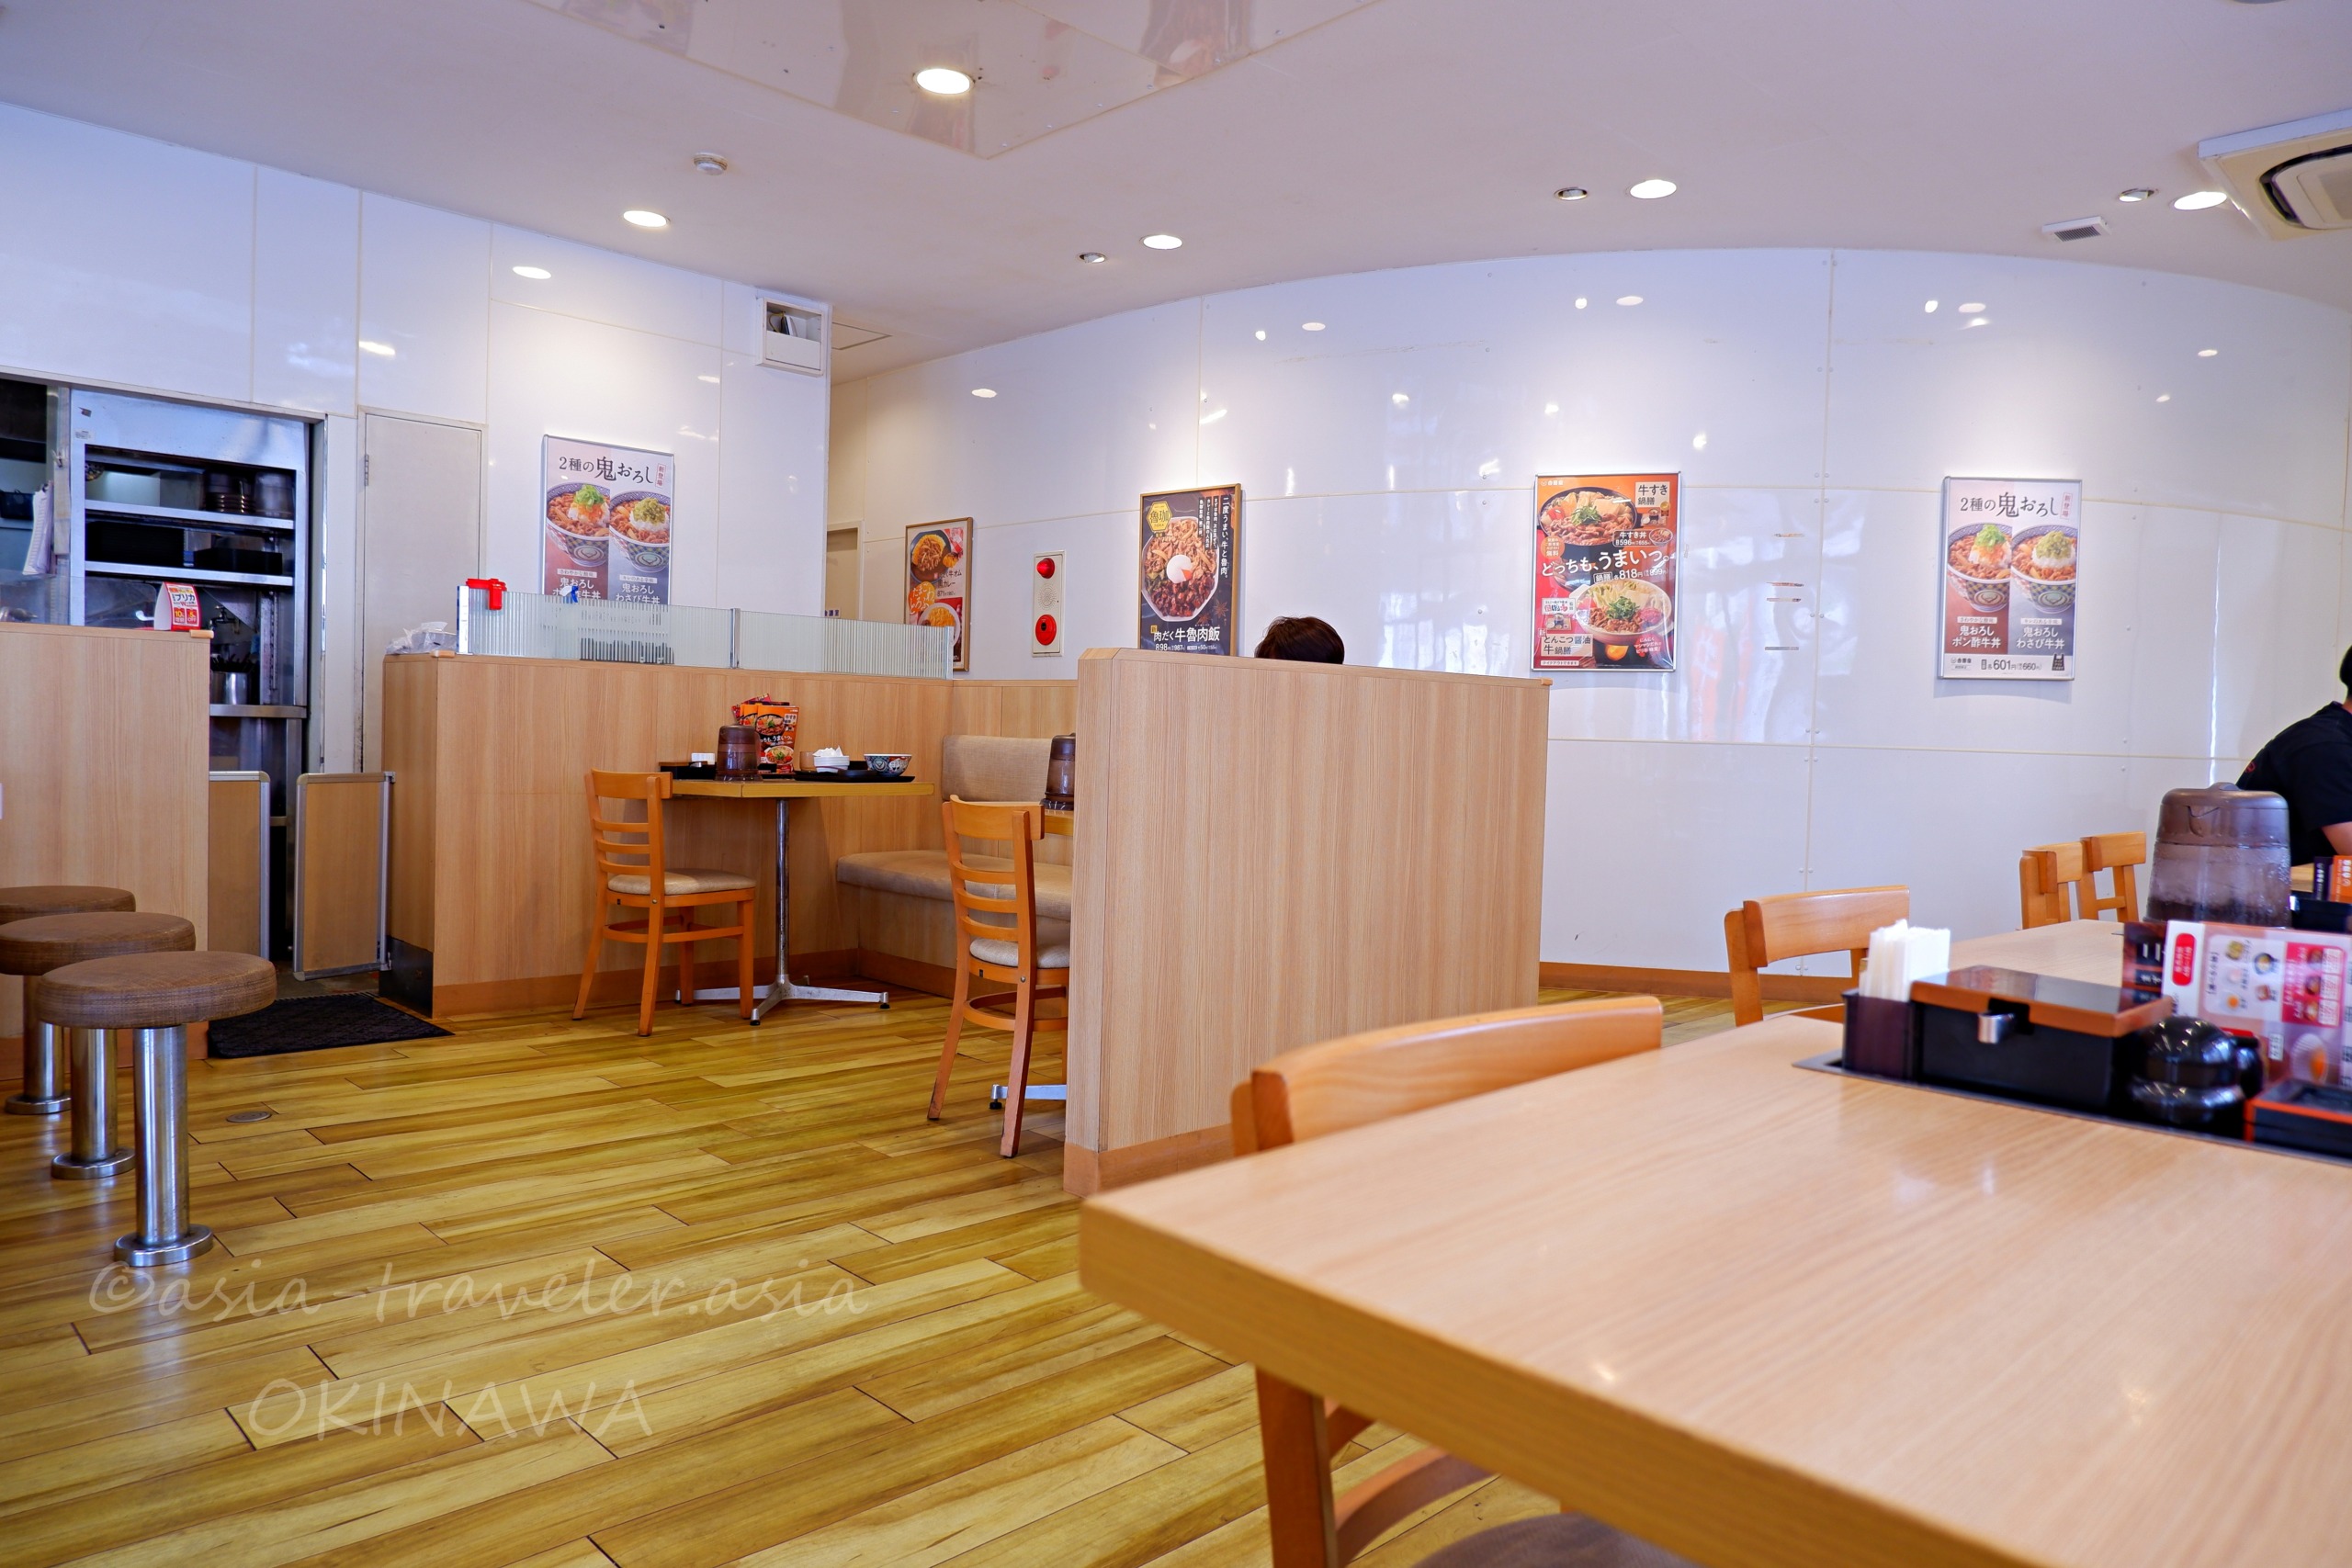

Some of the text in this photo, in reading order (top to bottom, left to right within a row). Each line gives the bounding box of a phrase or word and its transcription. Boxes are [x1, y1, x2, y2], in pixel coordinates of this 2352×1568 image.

[559, 456, 654, 484] 2種の鬼おろし
[1638, 485, 1668, 496] 牛すき
[1960, 492, 2059, 518] 2種の鬼おろし
[1150, 510, 1170, 524] 魯珈
[1619, 531, 1647, 539] 牛すき丼
[560, 577, 594, 590] 鬼おろし
[622, 582, 655, 595] 鬼おろし
[616, 592, 661, 604] わさび牛丼
[1153, 626, 1220, 643] 肉だく牛魯肉飯
[1960, 626, 1995, 637] 鬼おろし
[2023, 626, 2059, 637] 鬼おろし
[1544, 635, 1591, 644] とんこつ醤油
[1951, 637, 2001, 649] ポン酢牛丼
[2016, 638, 2064, 649] わさび牛丼
[1544, 645, 1571, 655] 牛鍋膳
